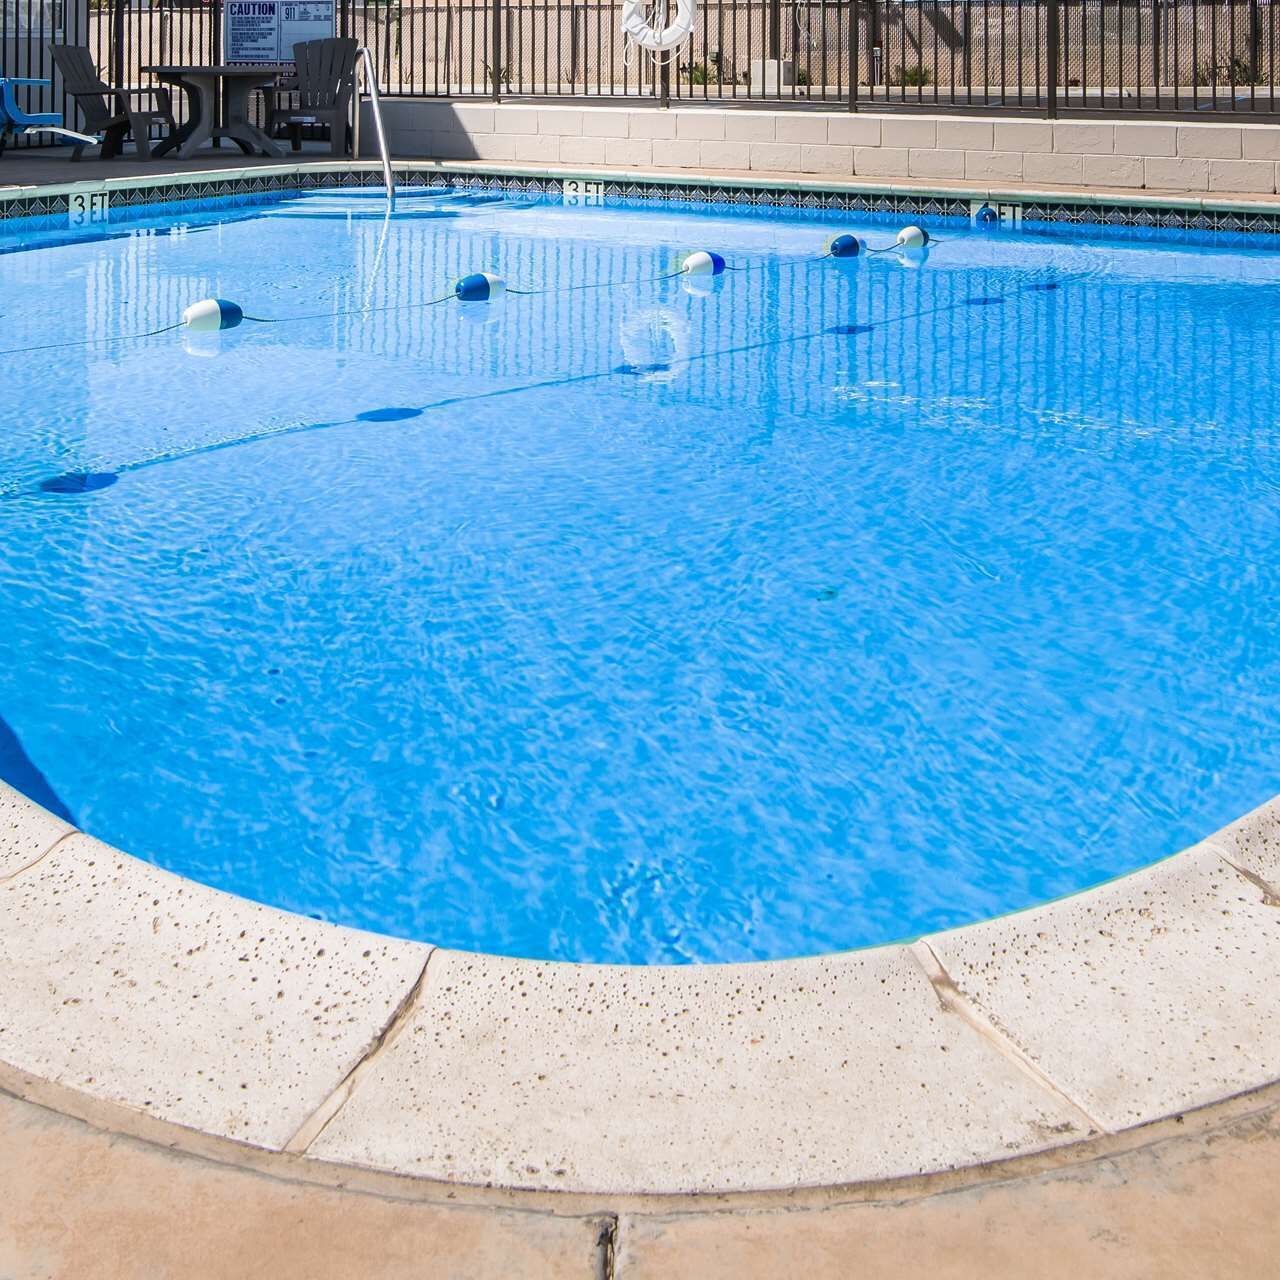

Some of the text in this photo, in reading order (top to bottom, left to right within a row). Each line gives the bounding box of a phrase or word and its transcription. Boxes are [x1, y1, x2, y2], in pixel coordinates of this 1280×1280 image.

[230, 3, 276, 16] CAUTION
[285, 7, 296, 20] 911
[73, 194, 86, 216] 3
